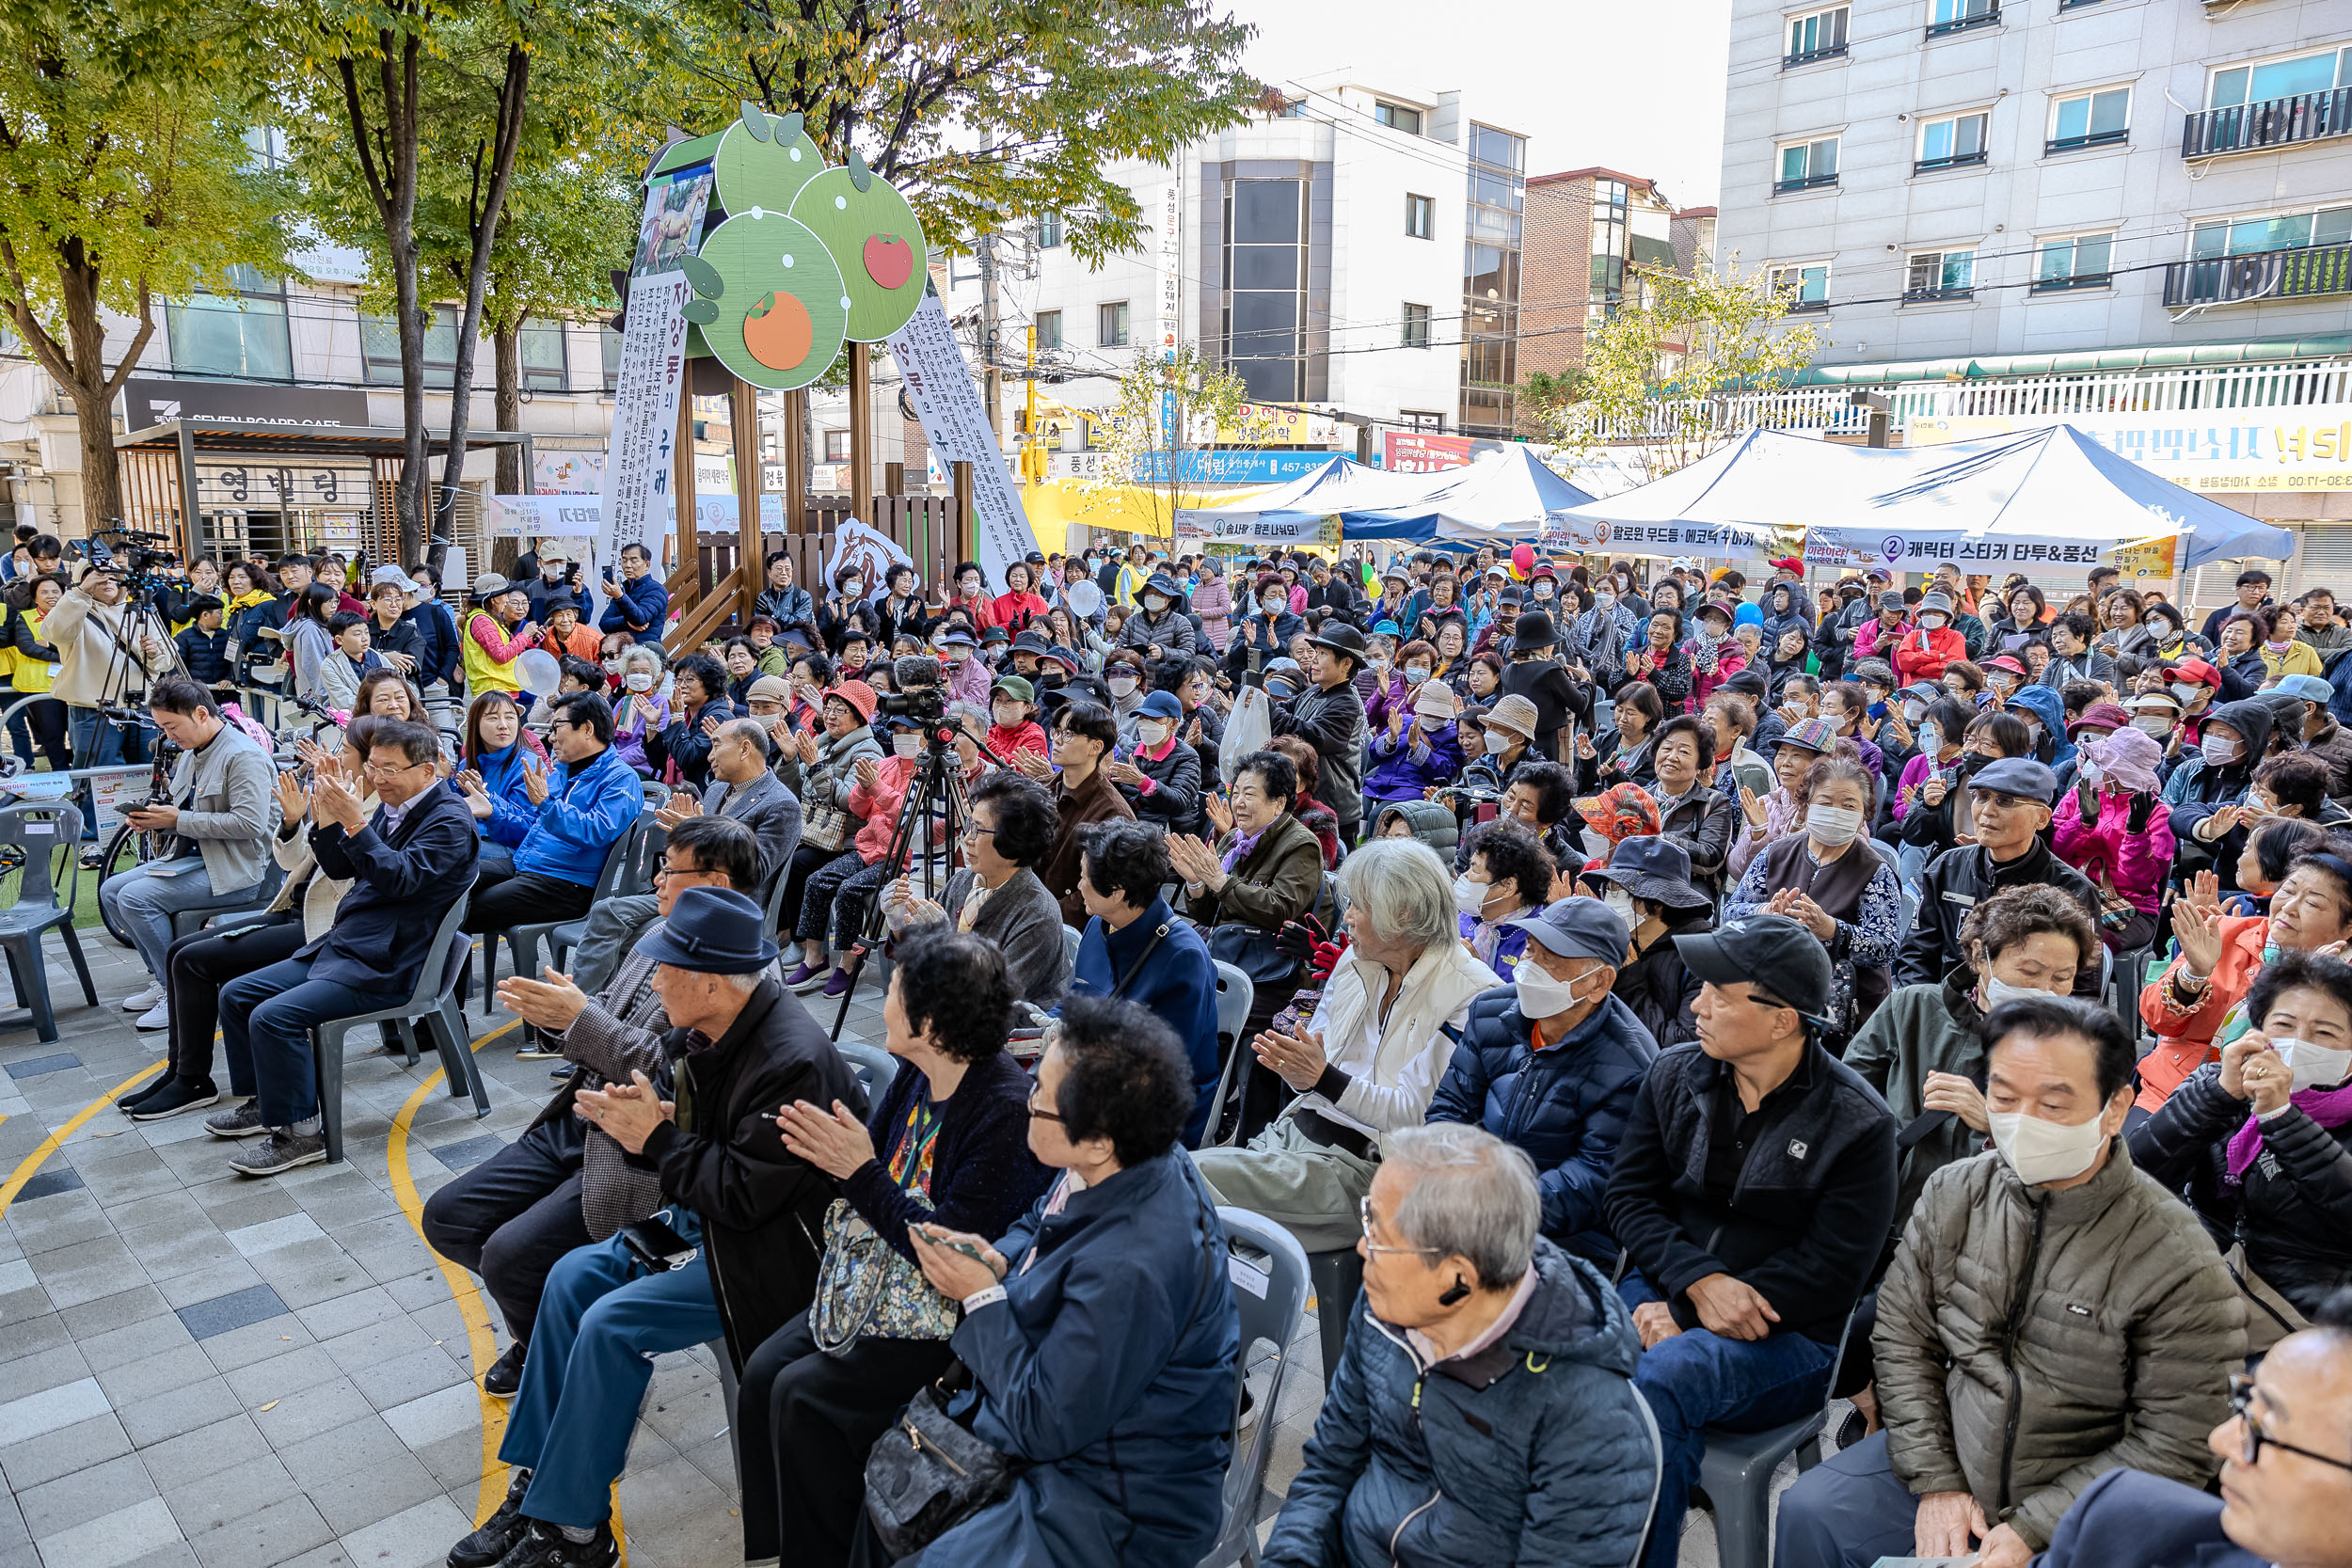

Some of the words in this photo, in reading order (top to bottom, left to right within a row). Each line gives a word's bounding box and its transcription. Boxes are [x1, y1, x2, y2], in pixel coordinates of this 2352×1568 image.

[299, 254, 333, 263] 야간진료
[646, 287, 655, 313] 조선
[625, 290, 638, 355] 자마장이라
[664, 279, 688, 410] 자양동의
[654, 428, 671, 496] 유래
[1216, 521, 1222, 532] 4
[1271, 524, 1300, 536] 나눠요!
[1598, 525, 1607, 537] 3
[1613, 525, 1644, 542] 할로윈
[1807, 546, 1850, 558] 이랴이랴!
[1887, 540, 1899, 554] 2
[1907, 540, 1955, 559] 캐릭터
[1959, 542, 2009, 561] 스티커
[2012, 545, 2099, 563] 타투&풍선
[1805, 555, 1833, 565] 자신만만
[1833, 557, 1848, 565] 축제
[2114, 555, 2139, 564] 만들기
